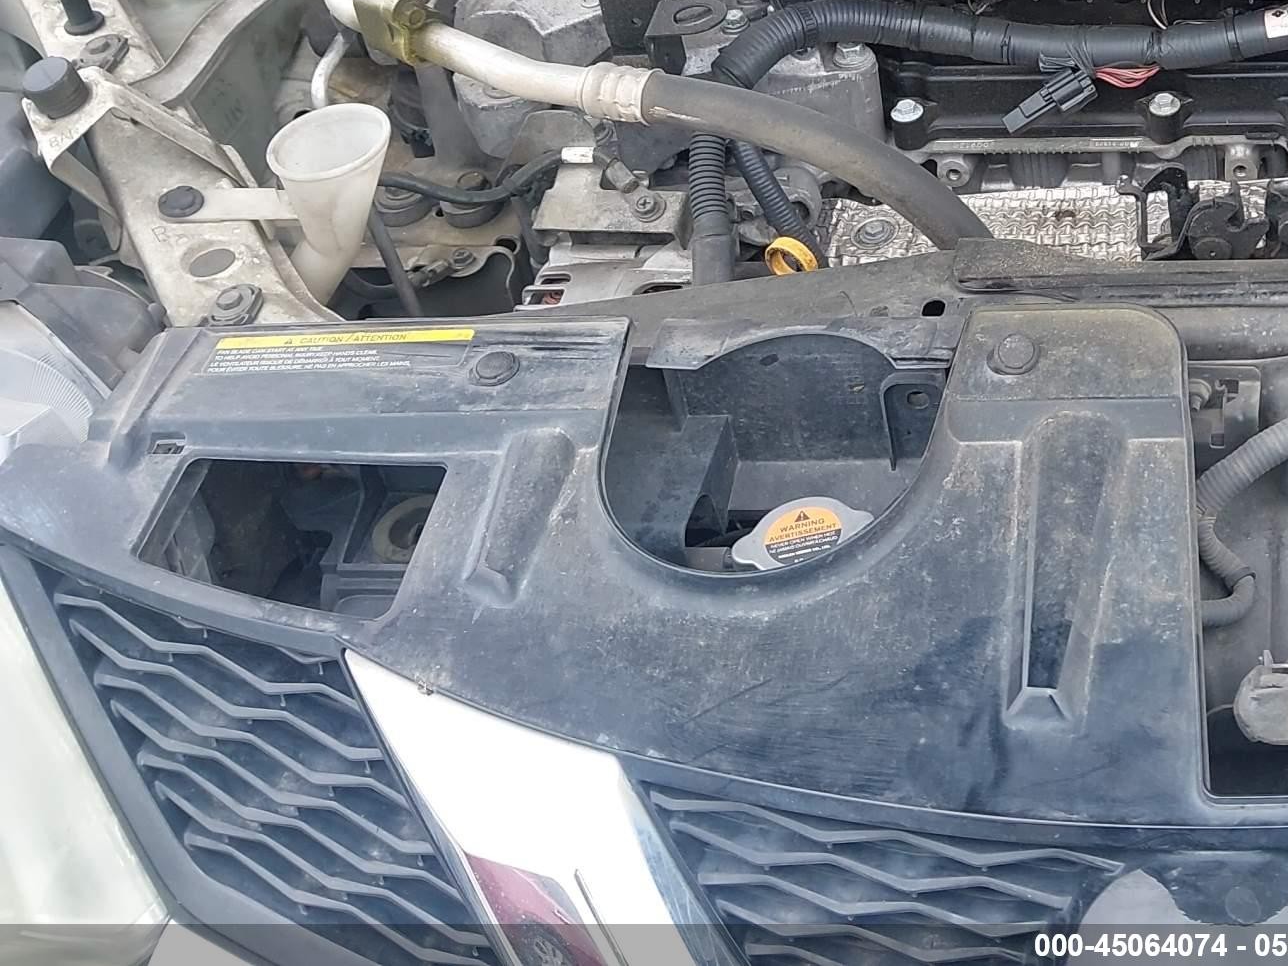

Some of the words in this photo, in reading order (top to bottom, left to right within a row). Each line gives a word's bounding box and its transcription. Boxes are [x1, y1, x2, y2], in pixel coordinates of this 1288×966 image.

[300, 334, 343, 344] CAUTION
[780, 518, 825, 532] WARNING
[769, 523, 836, 542] AVERTISSEMENT
